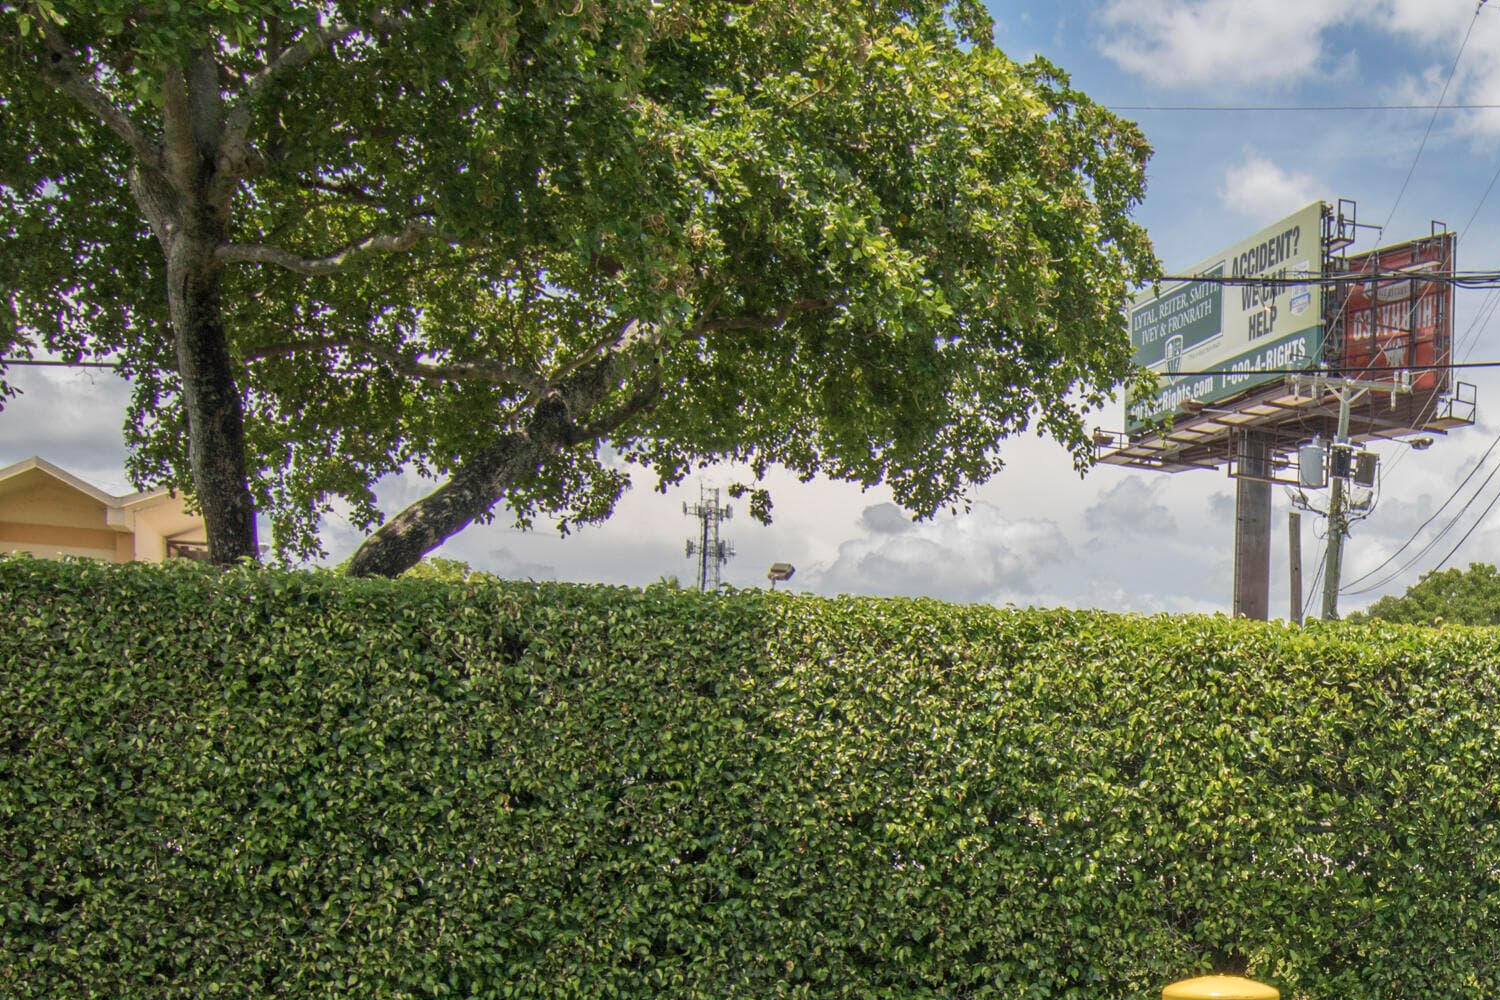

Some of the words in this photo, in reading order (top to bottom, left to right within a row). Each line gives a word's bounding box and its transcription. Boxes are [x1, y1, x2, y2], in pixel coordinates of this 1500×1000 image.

[1232, 225, 1300, 278] ACCIDENT?
[1242, 282, 1259, 311] WE
[1142, 325, 1159, 345] IVEY
[1160, 322, 1167, 337] &
[1168, 297, 1212, 333] FRONRATH
[1248, 305, 1278, 341] HELP
[1221, 337, 1306, 388] 1-800-4-RIGHTS
